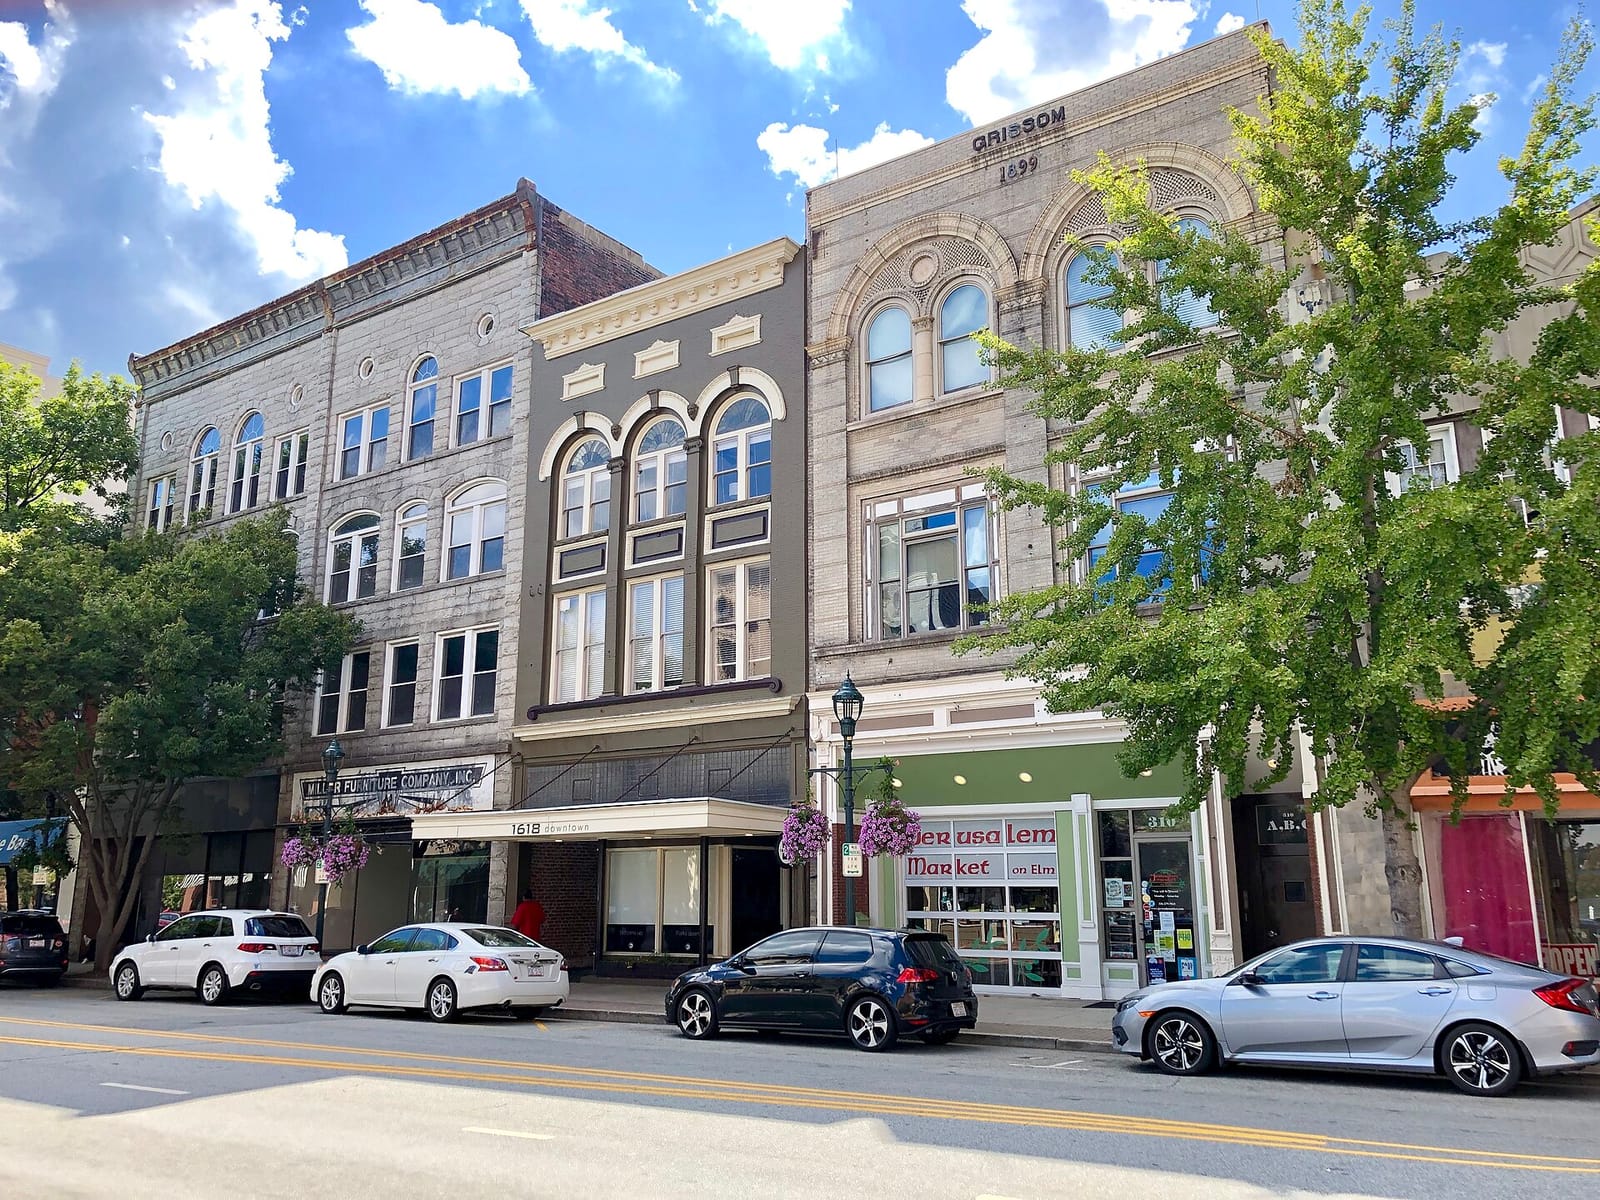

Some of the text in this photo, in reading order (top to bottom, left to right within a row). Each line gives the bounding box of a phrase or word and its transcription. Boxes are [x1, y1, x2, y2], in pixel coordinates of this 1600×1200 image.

[973, 105, 1066, 151] GRISSOM
[1000, 154, 1038, 183] 1899
[344, 777, 398, 793] FURNITURE
[511, 823, 590, 835] 1618 downtown
[1148, 815, 1176, 828] 310
[843, 844, 849, 855] 2
[907, 856, 1056, 876] Market on Elm
[1550, 947, 1598, 976] OPEN
